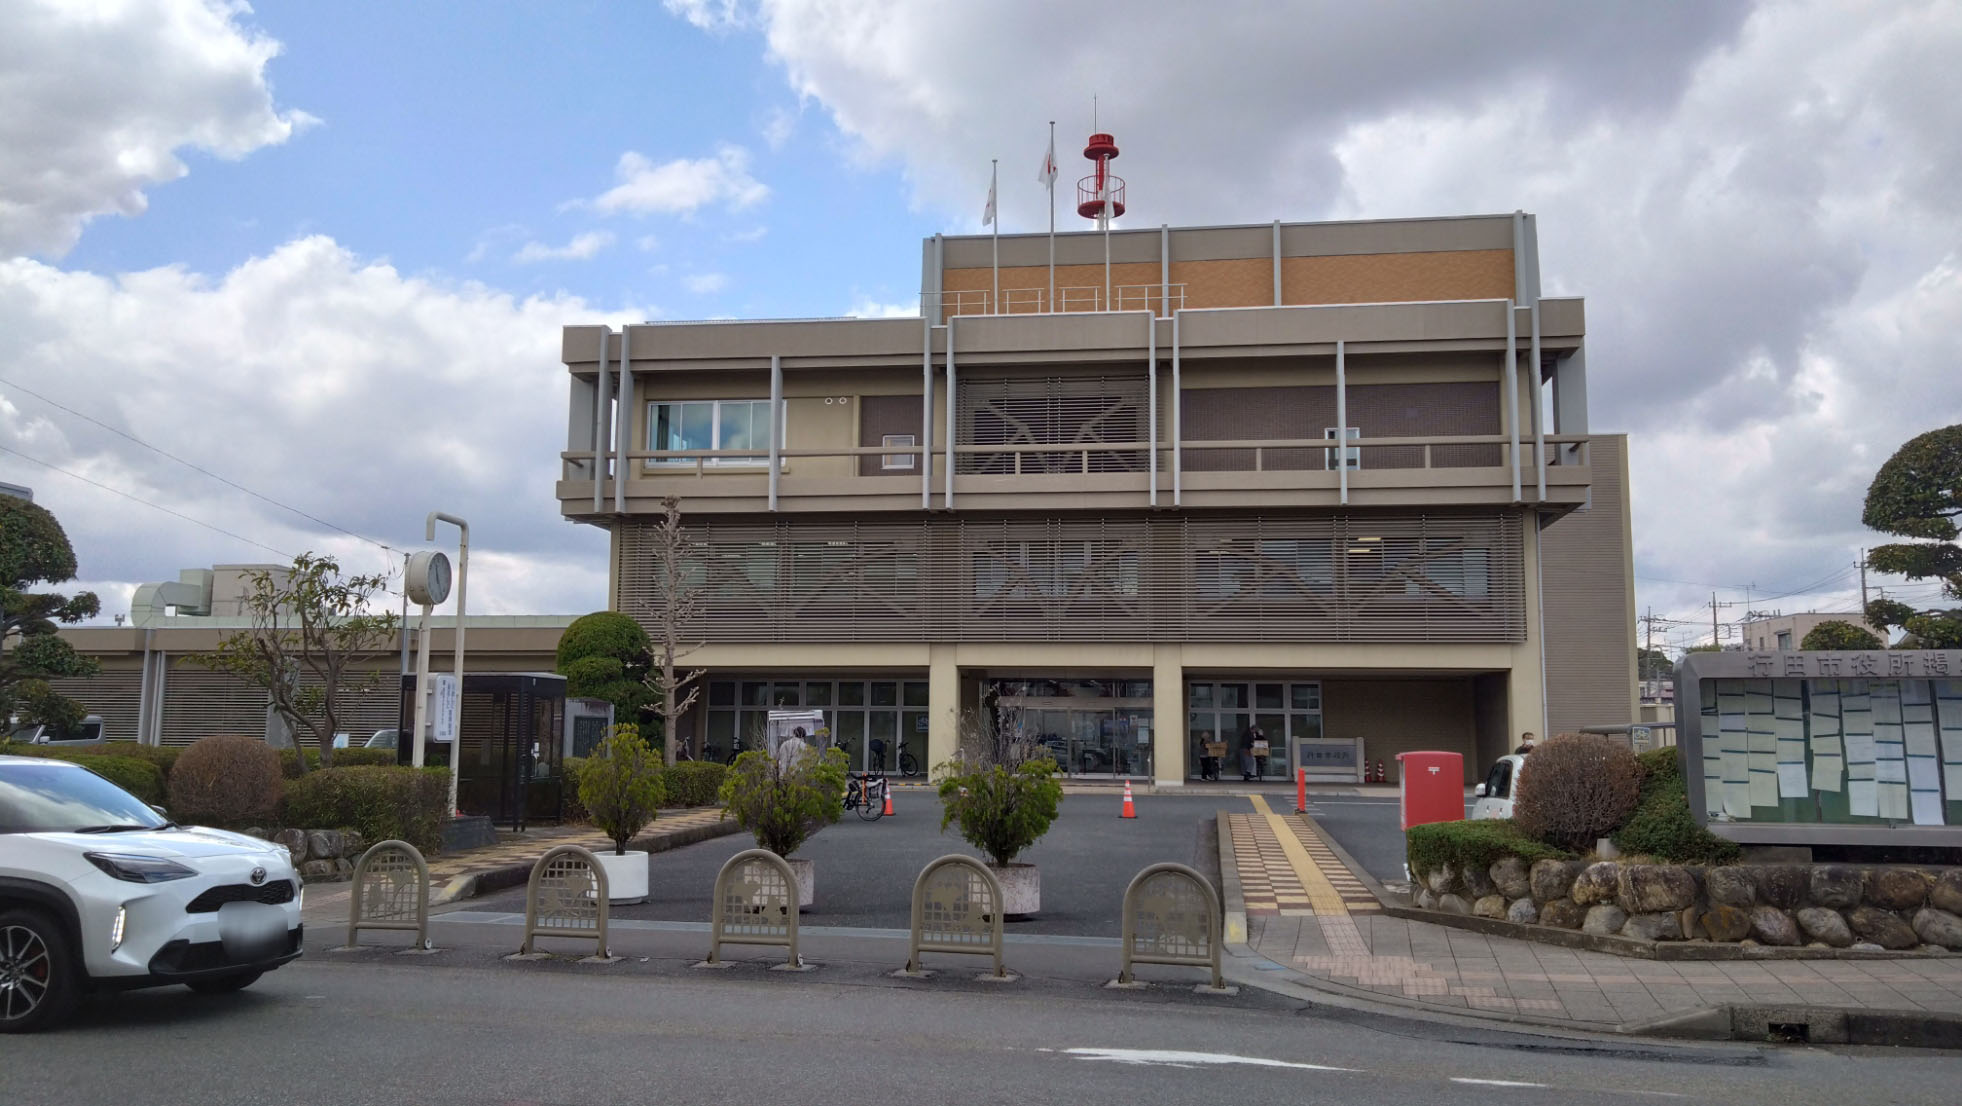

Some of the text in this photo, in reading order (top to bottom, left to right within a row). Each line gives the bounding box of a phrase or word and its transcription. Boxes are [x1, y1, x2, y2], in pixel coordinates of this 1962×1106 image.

[1748, 652, 1962, 677] 行田市役所掲
